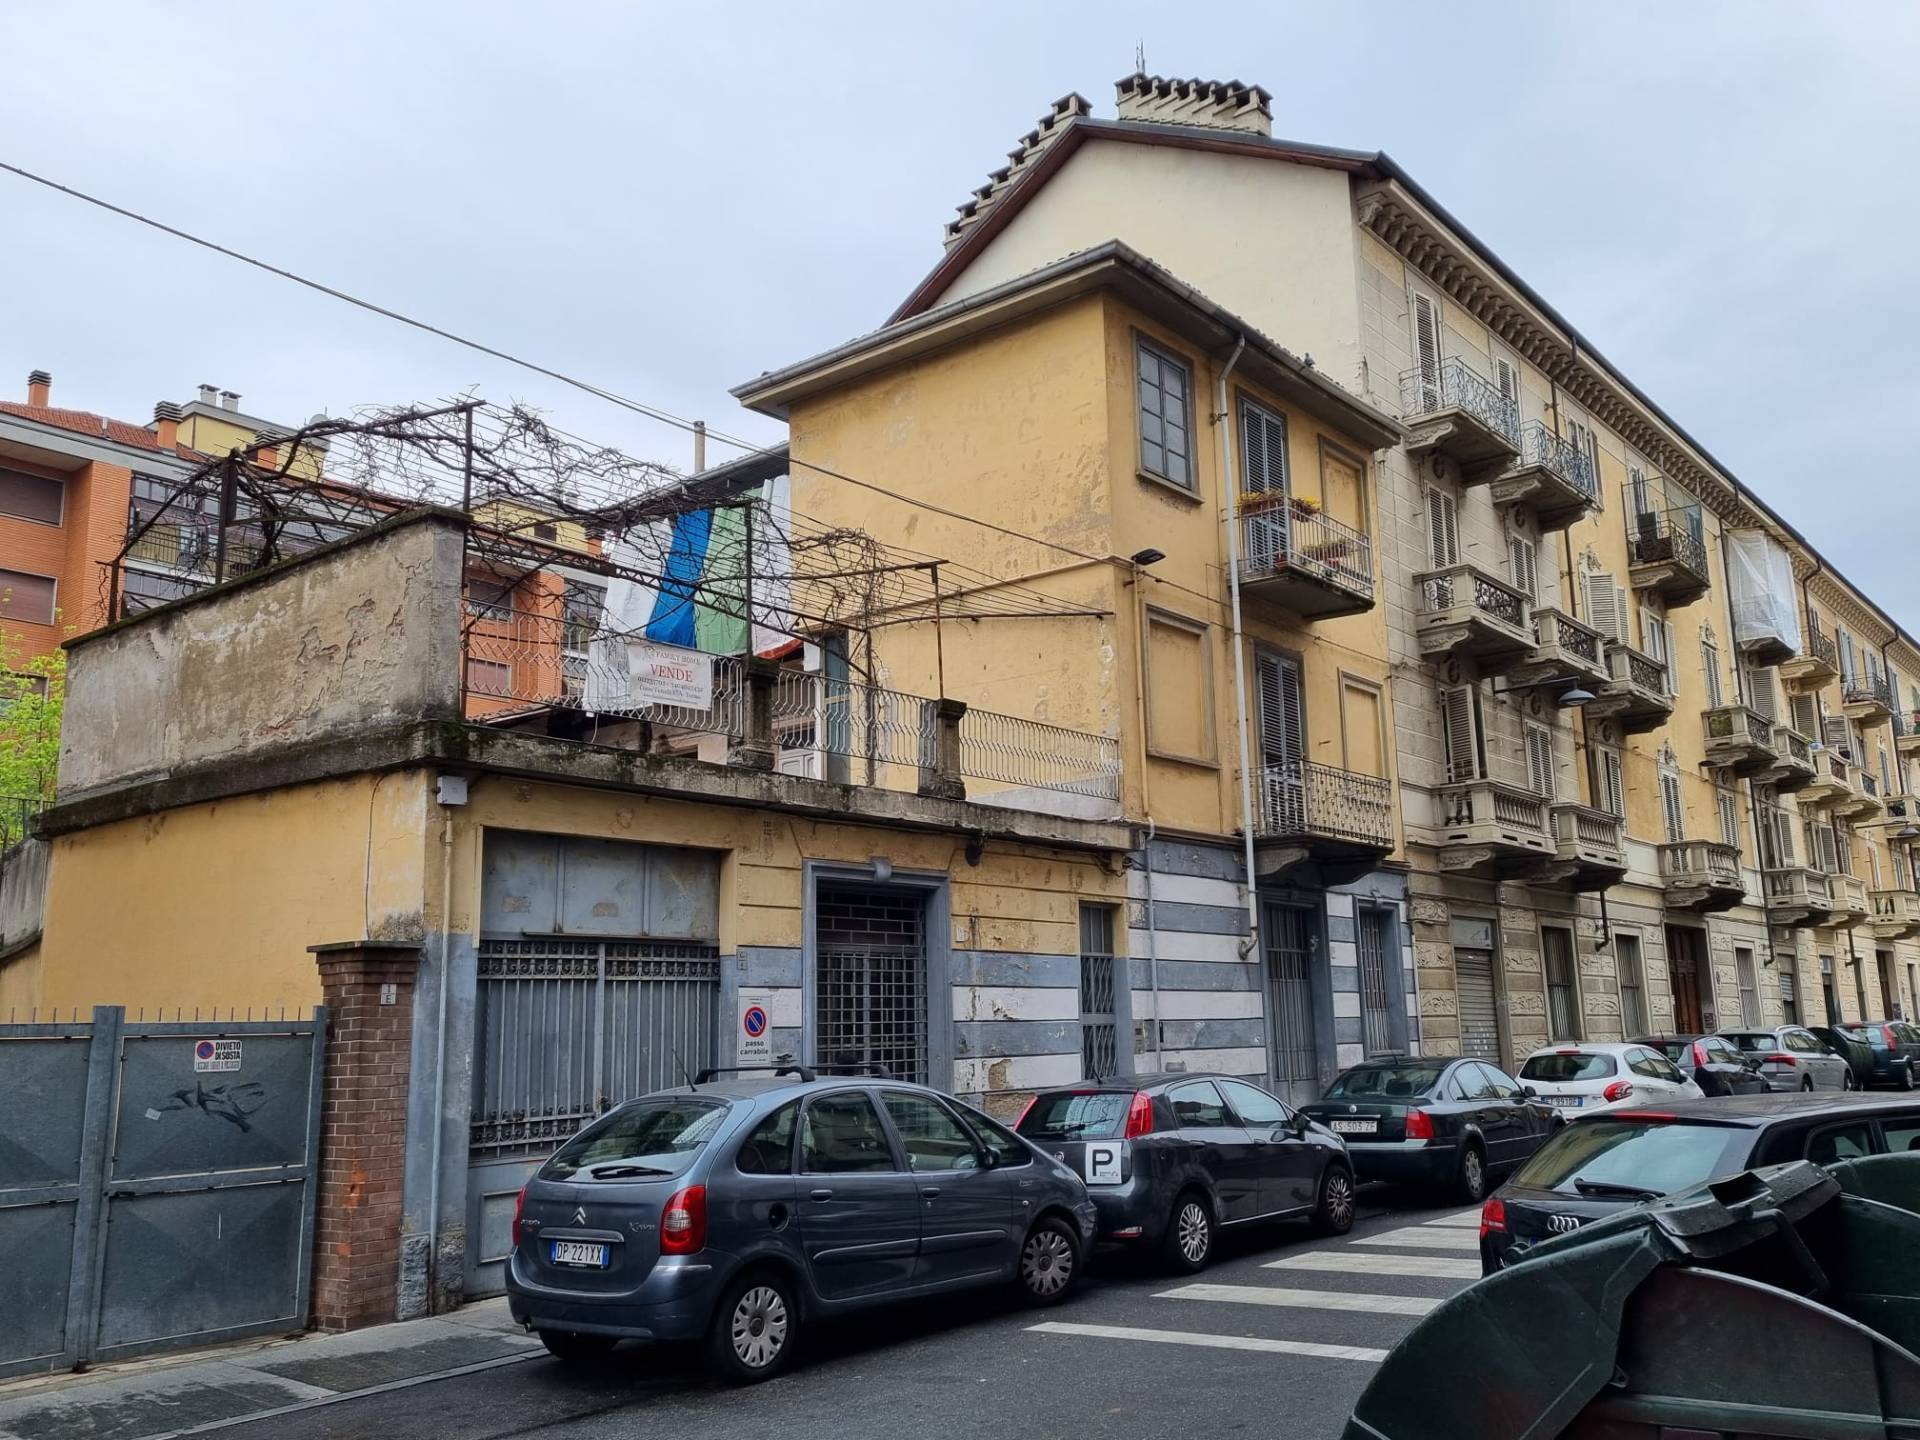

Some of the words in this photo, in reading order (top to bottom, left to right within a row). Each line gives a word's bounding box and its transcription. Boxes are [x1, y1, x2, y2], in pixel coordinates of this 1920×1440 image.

[650, 663, 694, 683] VENDE
[215, 1041, 241, 1051] DIVIETO
[215, 1051, 222, 1060] DI
[222, 1050, 241, 1060] SOSTA
[1092, 1149, 1113, 1177] P
[557, 1243, 568, 1259] DP
[572, 1244, 602, 1263] 221XX
